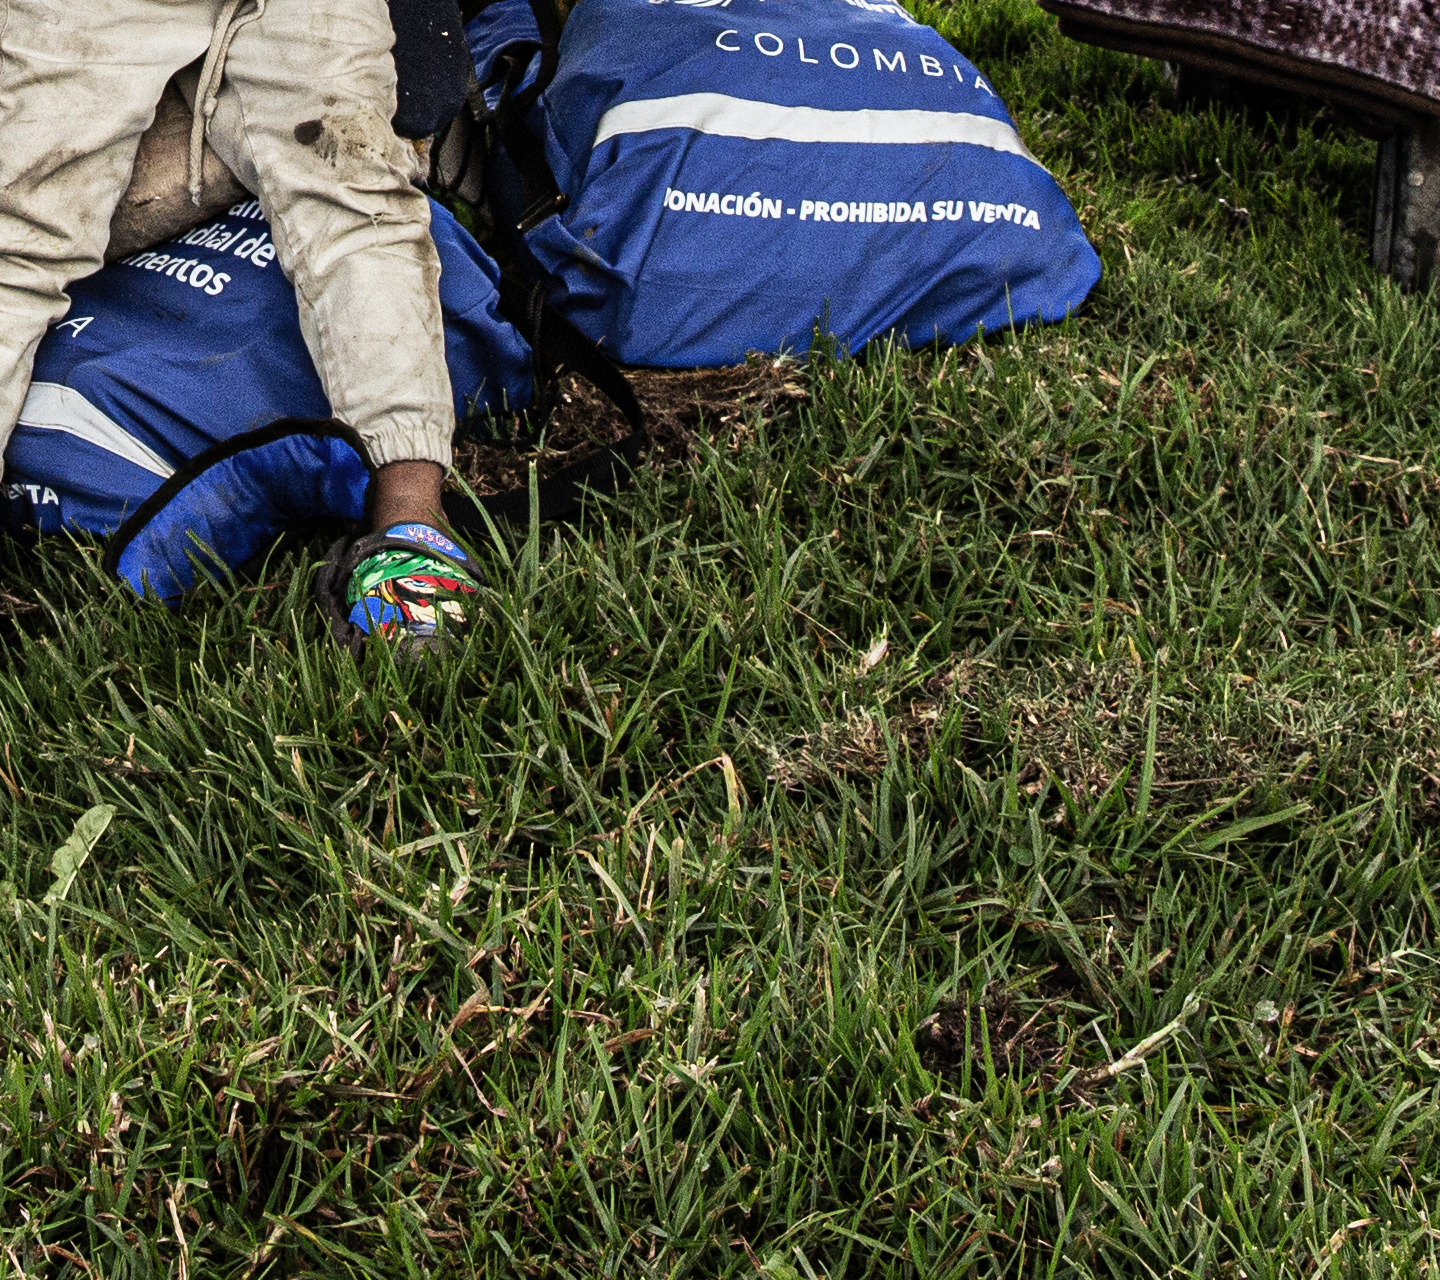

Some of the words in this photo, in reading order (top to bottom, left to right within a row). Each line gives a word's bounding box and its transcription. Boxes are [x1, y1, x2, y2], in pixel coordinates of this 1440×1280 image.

[715, 29, 994, 97] COLOMBIA
[799, 199, 928, 223] PROHIBIDA
[931, 200, 964, 221] SU
[968, 200, 1041, 230] VENTA
[233, 232, 277, 268] de
[55, 316, 94, 338] A
